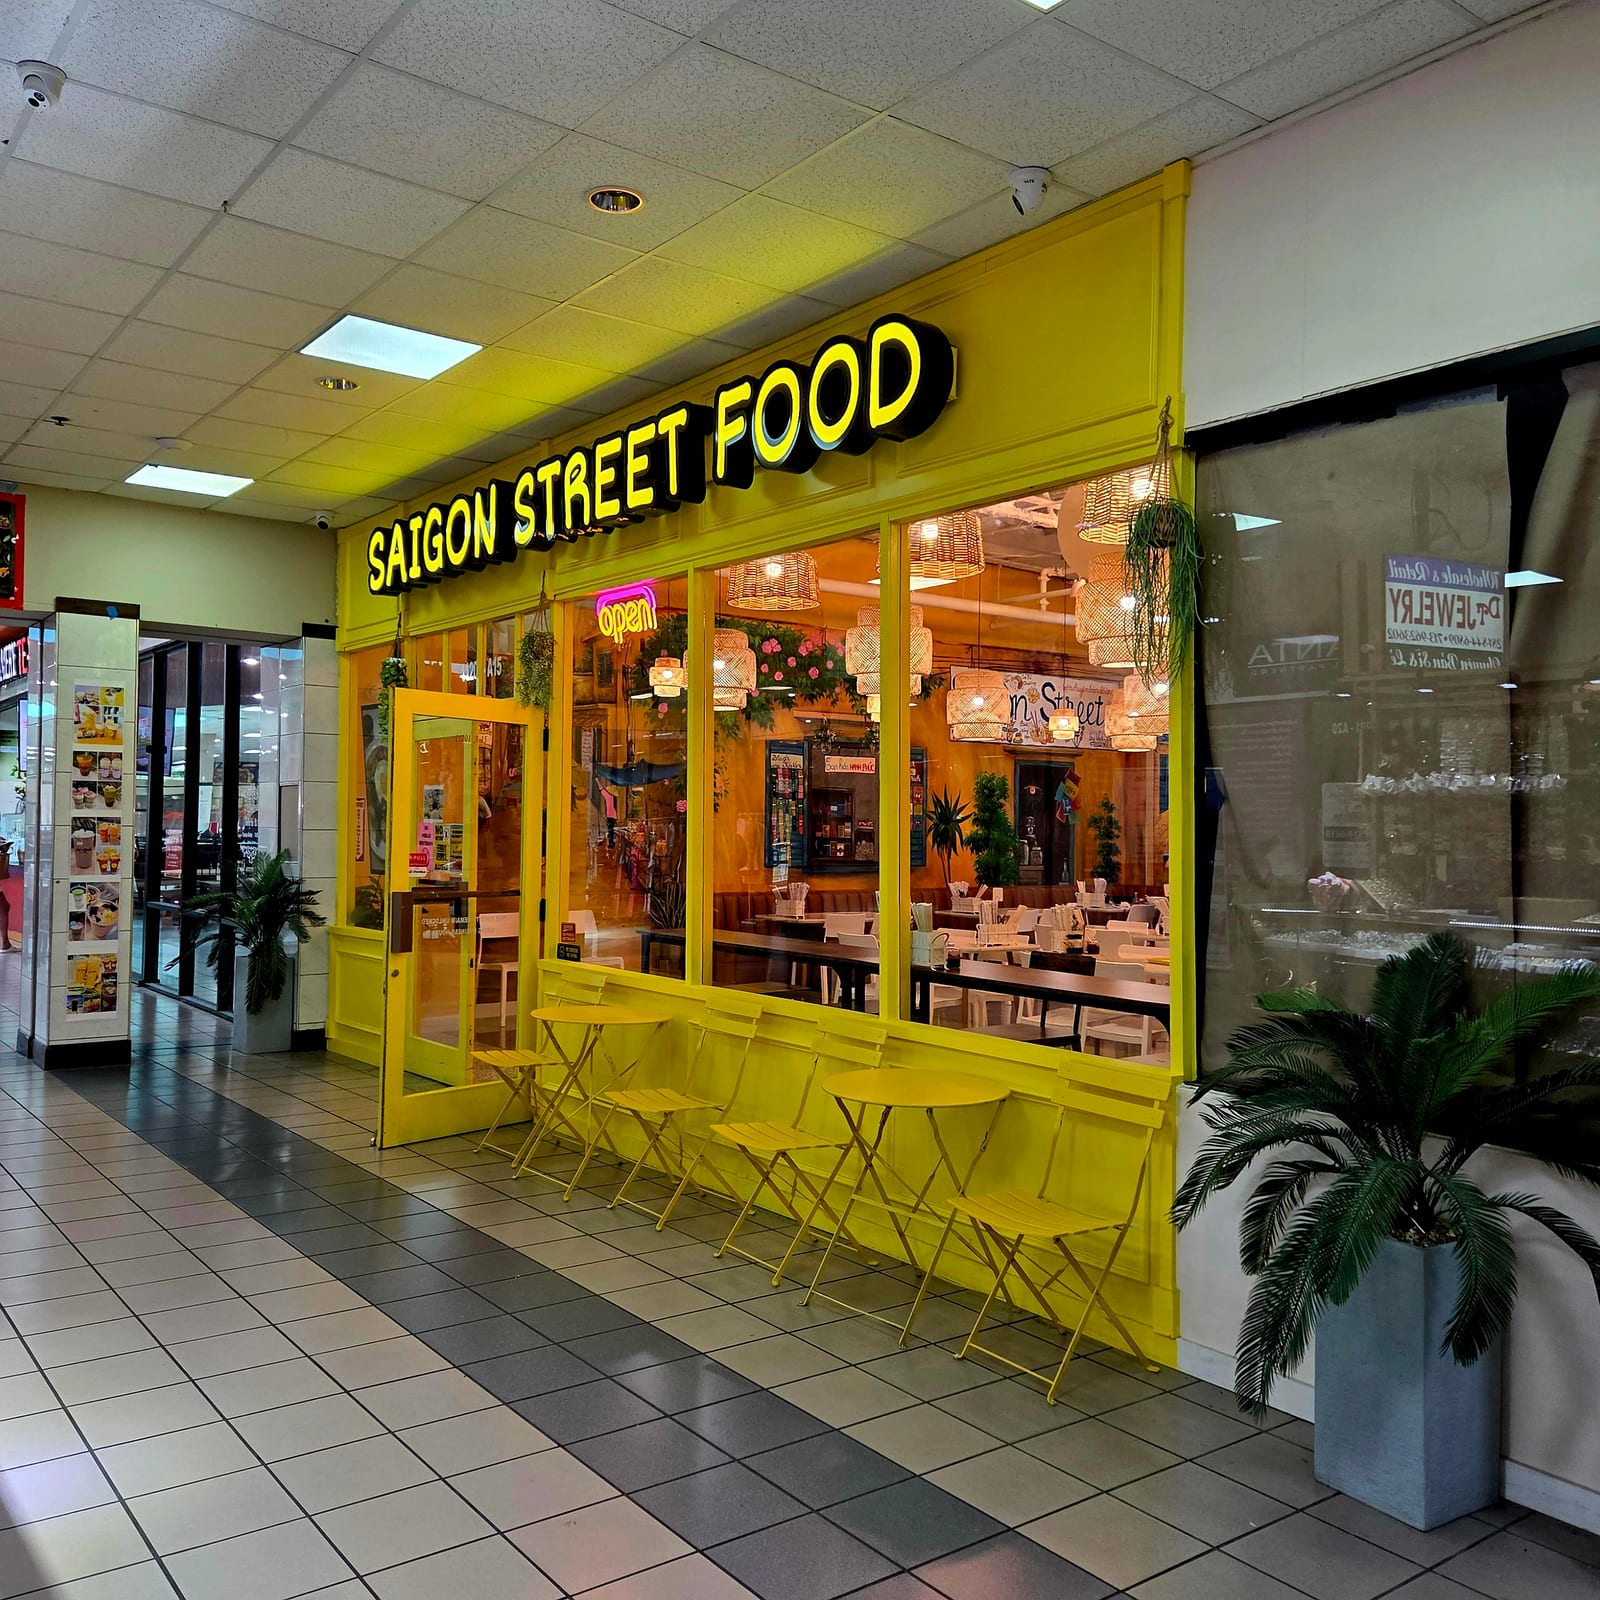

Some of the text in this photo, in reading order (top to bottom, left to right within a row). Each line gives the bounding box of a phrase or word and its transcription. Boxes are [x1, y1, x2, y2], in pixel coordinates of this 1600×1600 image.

[367, 317, 928, 595] SAIGON STREET FOOD
[598, 598, 653, 644] open
[1040, 681, 1105, 727] Street
